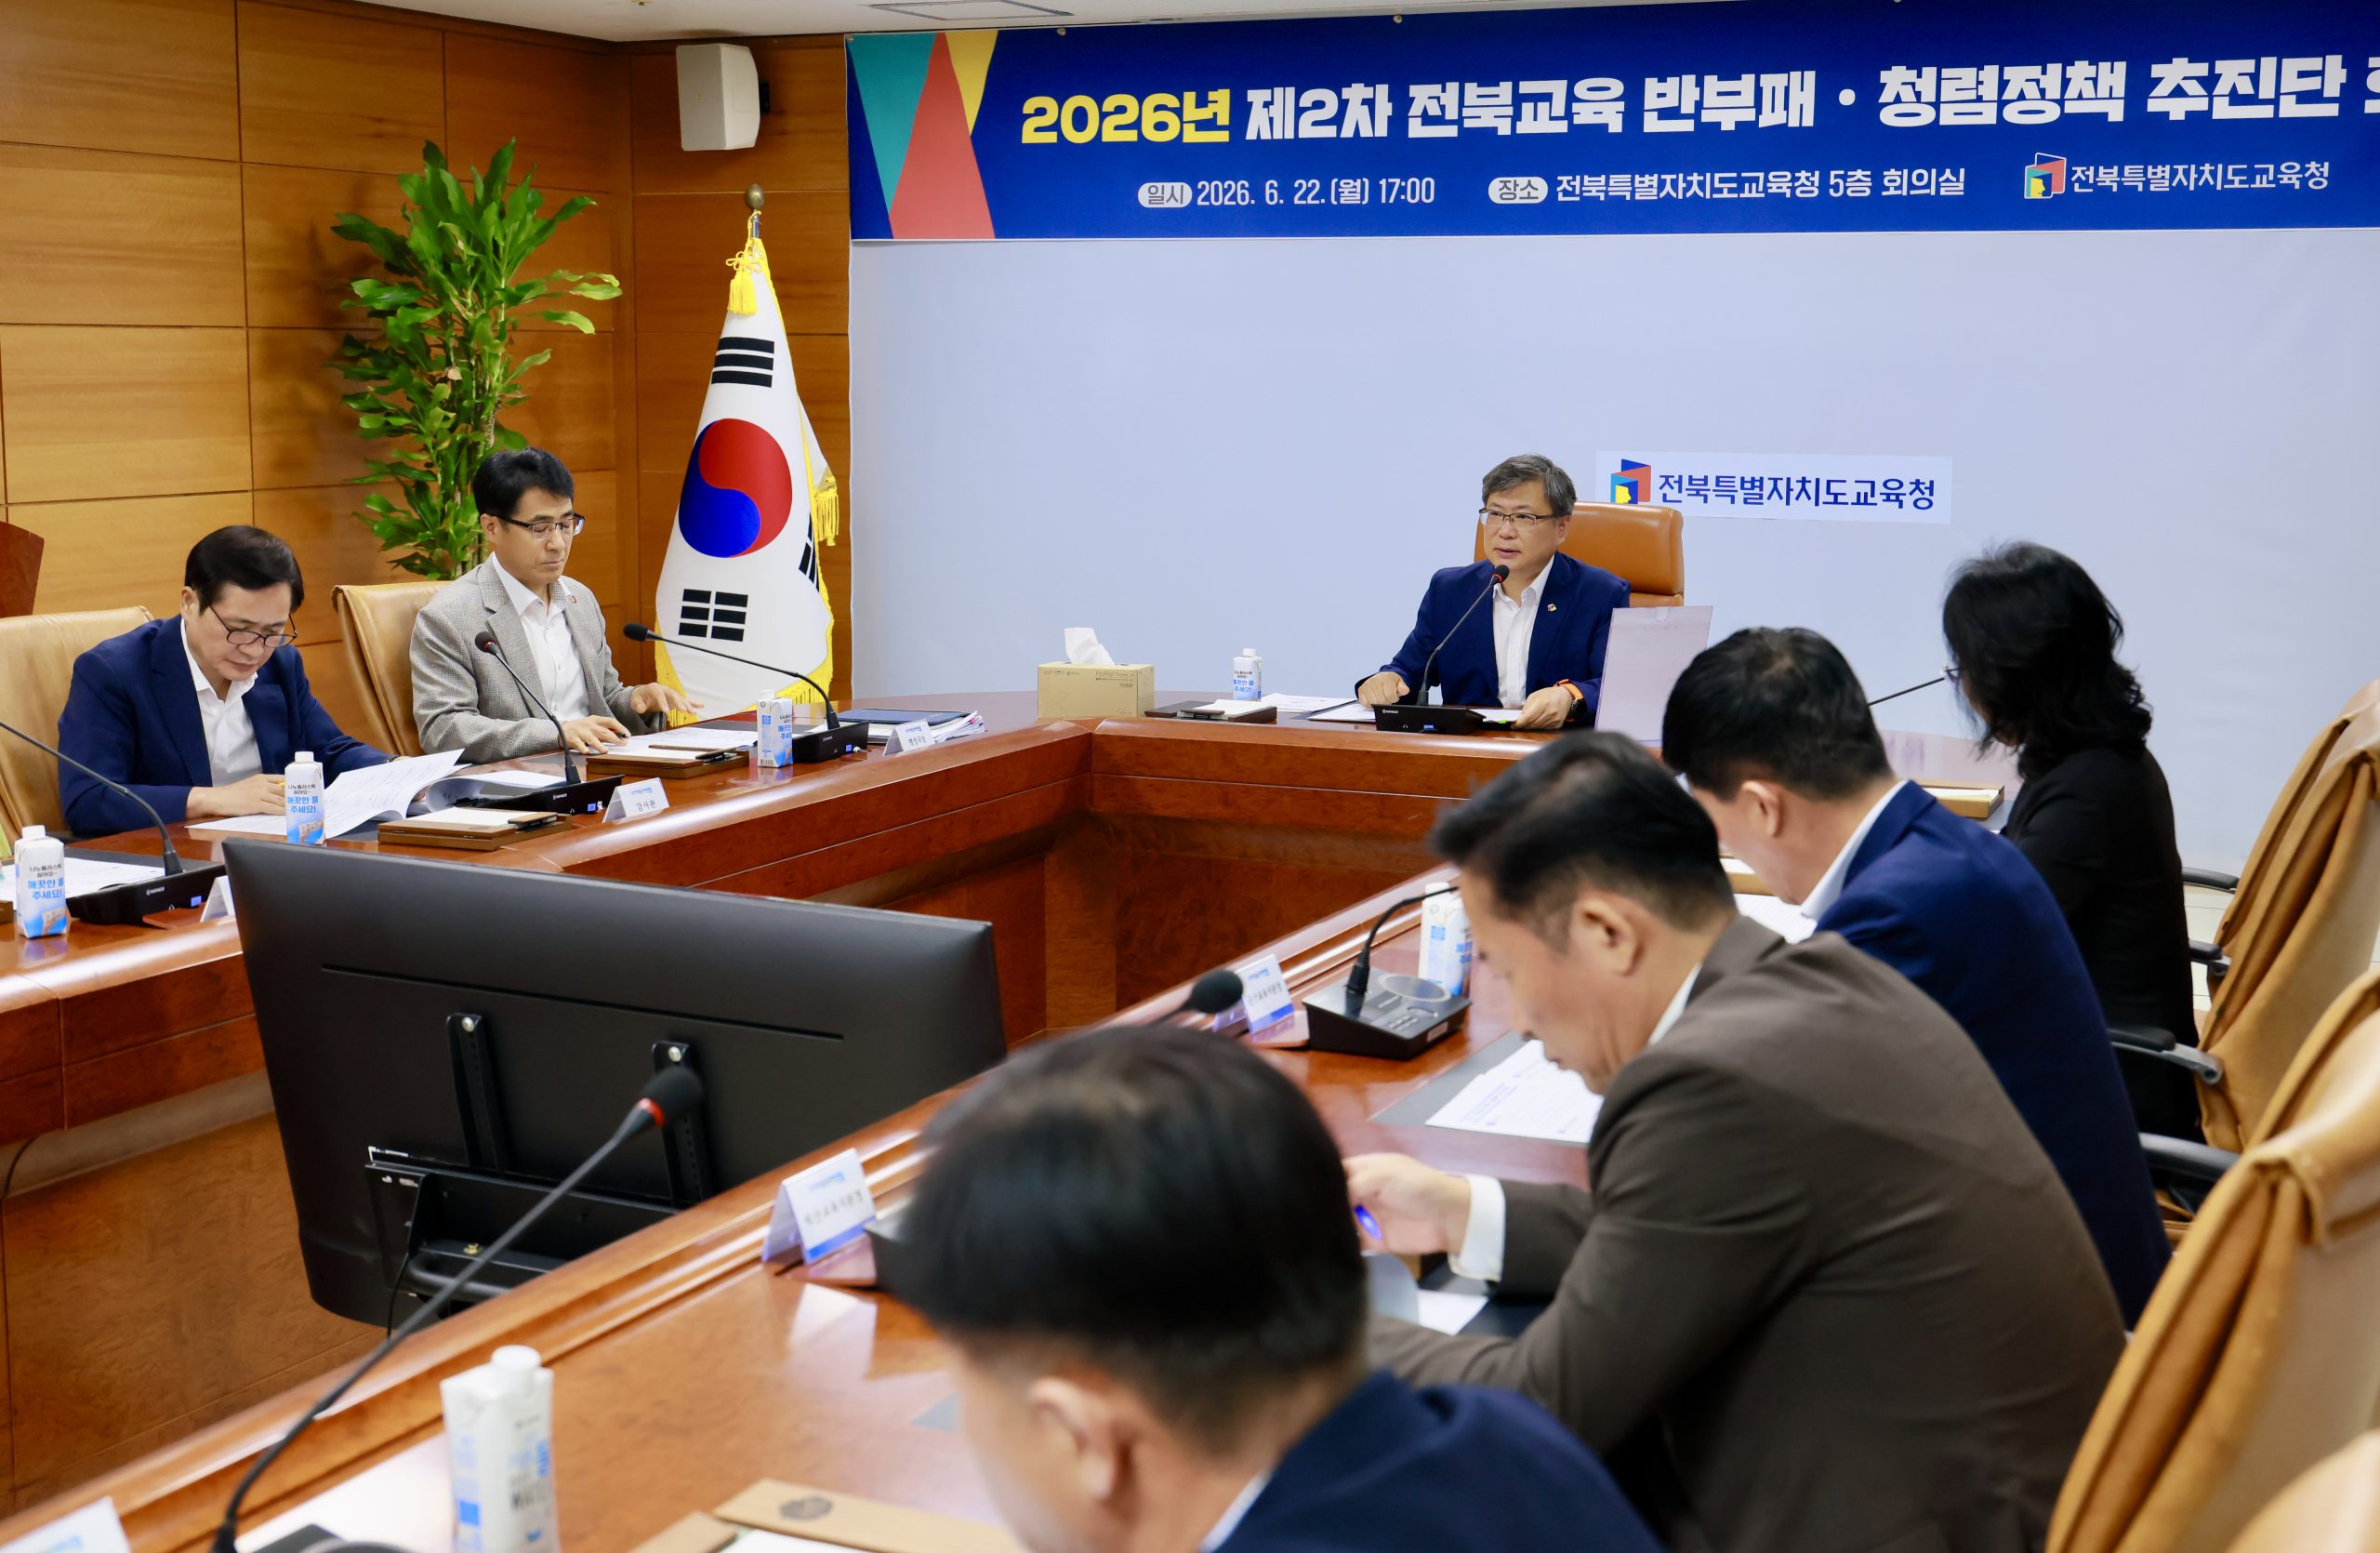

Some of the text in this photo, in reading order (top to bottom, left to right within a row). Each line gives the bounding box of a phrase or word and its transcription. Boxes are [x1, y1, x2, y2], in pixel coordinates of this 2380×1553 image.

[1022, 89, 1230, 143] 2026년
[1246, 84, 1392, 139] 제2차
[1408, 78, 1624, 138] 전북교육
[1644, 71, 1815, 132] 반부패
[1879, 60, 2126, 126] 청렴정책
[2148, 55, 2347, 120] 추진단
[1147, 184, 1183, 205] 일시
[1197, 180, 1255, 206] 2026.
[1265, 180, 1284, 206] 6.
[1380, 178, 1435, 203] 17:00
[1499, 168, 1965, 202] 장소 전북특별자치도교육청 5층 회의실
[2070, 161, 2330, 192] 전북특별자치도교육청
[1659, 474, 1935, 511] 전북특별자치도교육청
